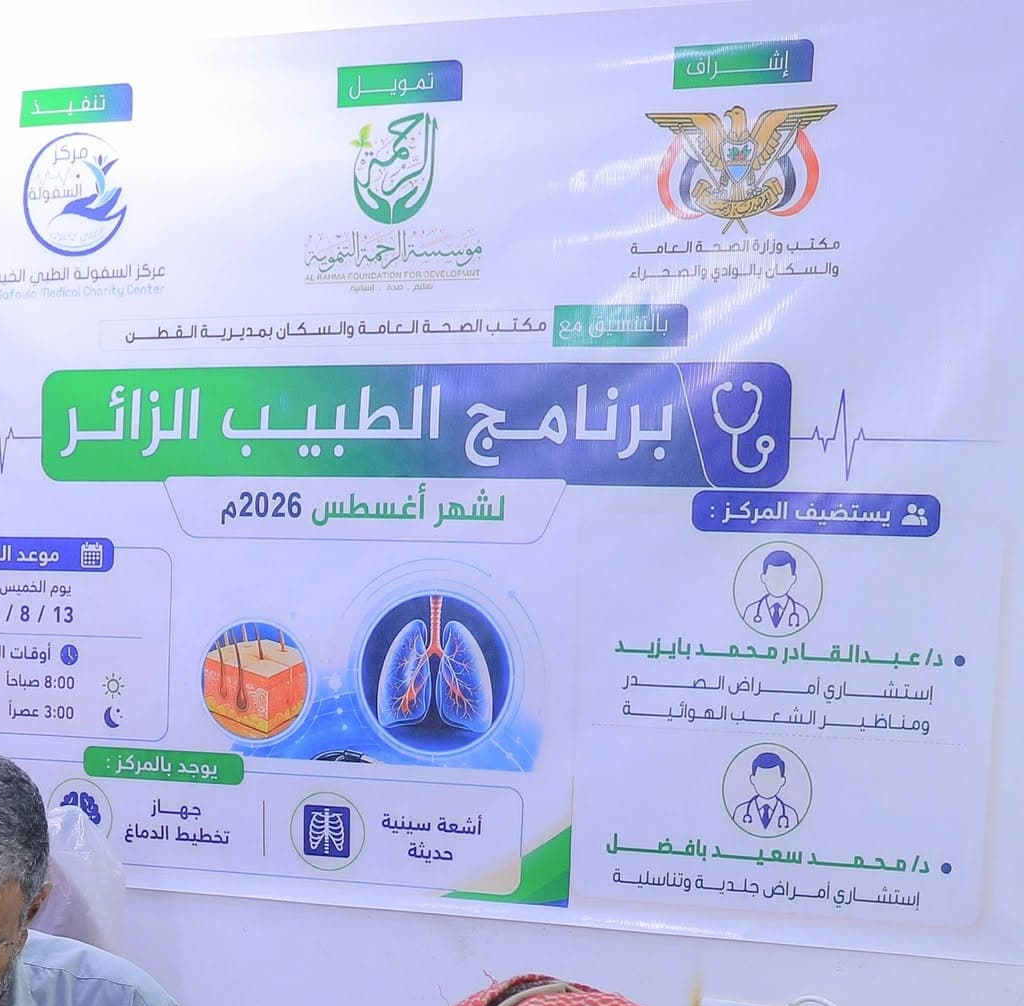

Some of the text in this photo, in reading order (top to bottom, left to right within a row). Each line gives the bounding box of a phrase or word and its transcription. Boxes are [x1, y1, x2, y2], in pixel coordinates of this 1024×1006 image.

[686, 49, 790, 80] إشراف
[348, 71, 435, 100] تمويل
[31, 94, 107, 117] تنفيذ
[51, 145, 89, 165] مركز
[28, 183, 83, 204] السفولة
[631, 238, 840, 256] مكتب وزارة الصحة العامة
[29, 265, 70, 284] الطبي
[73, 264, 132, 284] السفولة
[628, 262, 839, 283] والسكان بالوادي والصحراء
[125, 317, 547, 344] مكتب الصحة العامة والسكان بمديرية القطن
[558, 313, 669, 340] بالتنسيق مع
[59, 383, 673, 468] برنامج الطبيب الزائر
[221, 483, 506, 528] لشهر أغسطس 2026م
[721, 501, 789, 525] المركز
[794, 504, 892, 528] يستضيف
[16, 546, 60, 567] موعد
[0, 580, 46, 597] الخميس
[50, 582, 72, 598] يوم
[19, 604, 31, 623] 8
[53, 605, 75, 624] 13
[10, 643, 52, 664] أوقات
[614, 636, 692, 661] بايزيد
[695, 641, 778, 660] محمد
[44, 674, 75, 690] 8:00
[621, 673, 935, 705] إستشاري أمراض الصدر
[44, 704, 74, 719] 3:00
[622, 700, 931, 735] ومناظير الشعب الهوائية
[115, 754, 173, 777] بالمركز
[177, 761, 218, 780] يوجد
[150, 798, 202, 821] جهاز
[124, 823, 230, 847] تخطيط الدماغ
[381, 812, 483, 836] أشعة سينية
[407, 841, 454, 864] حديثة
[606, 832, 708, 861] بافضل
[711, 842, 803, 867] سعيد
[807, 850, 908, 873] محمد
[612, 867, 921, 912] إستشاري أمراض جلدية وتناسلية
